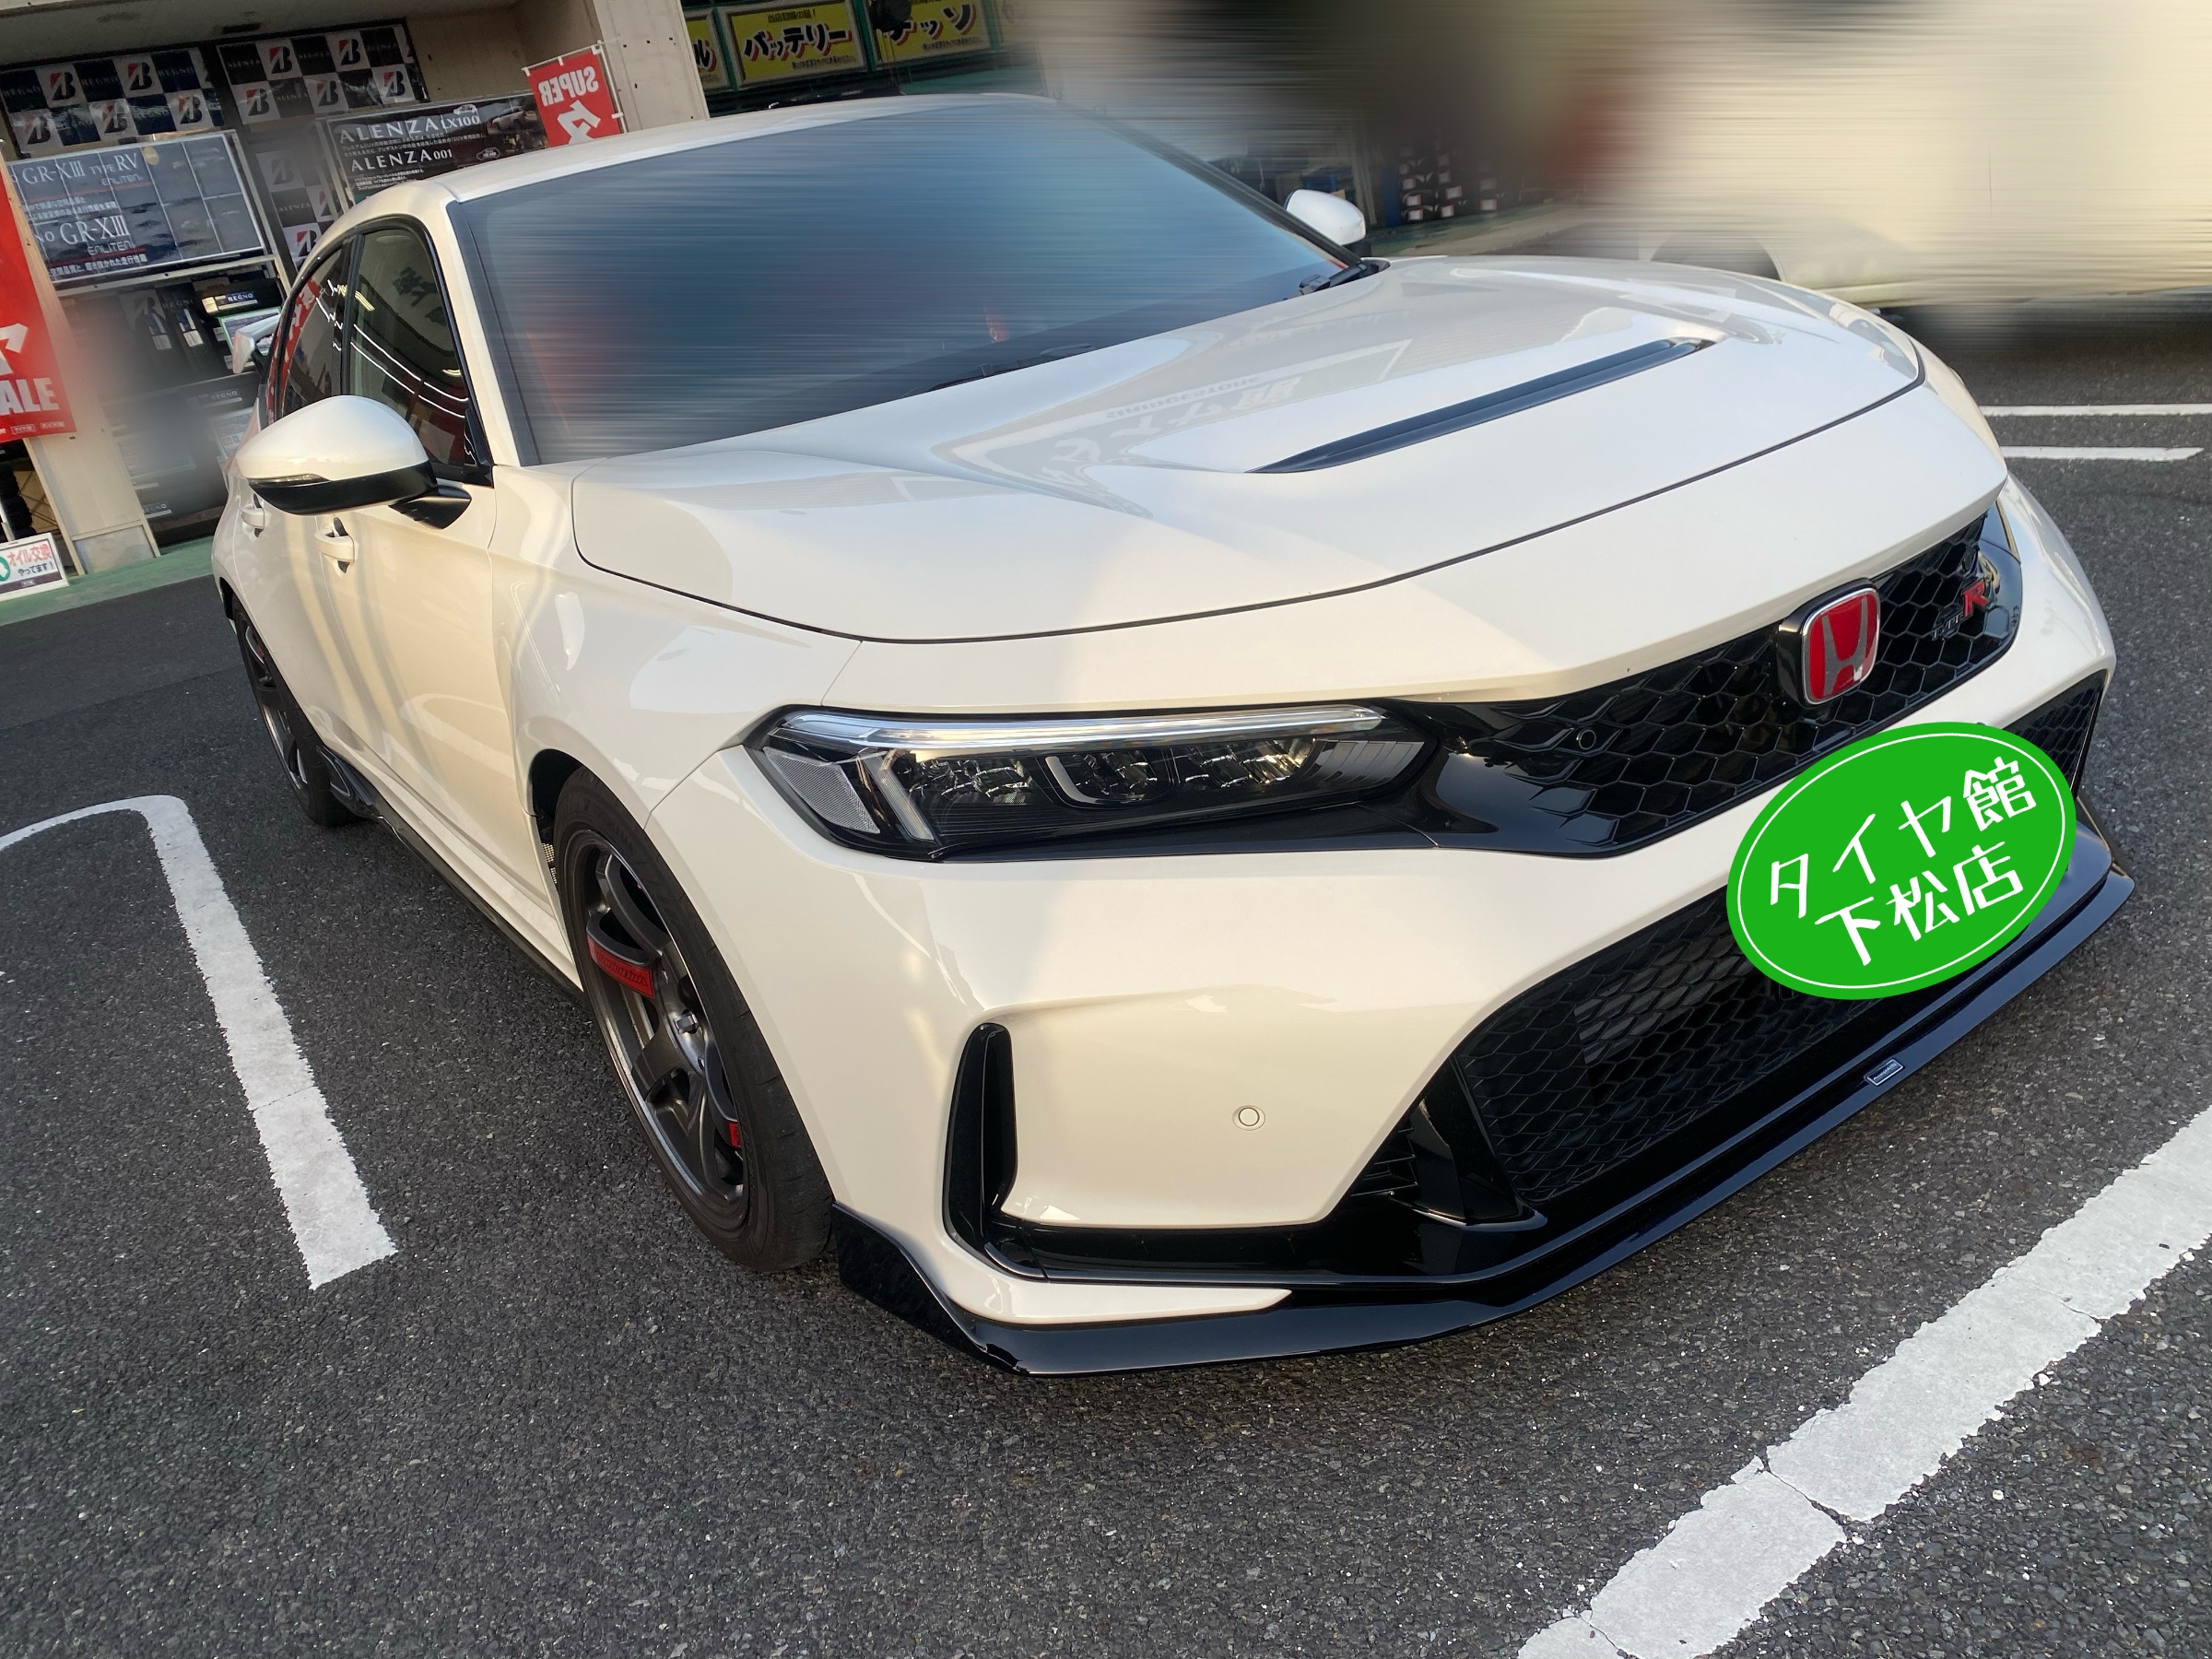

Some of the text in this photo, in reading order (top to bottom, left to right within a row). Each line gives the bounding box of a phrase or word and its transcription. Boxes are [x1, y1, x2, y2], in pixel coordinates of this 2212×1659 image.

[743, 23, 852, 61] バッテリー
[339, 116, 440, 145] ALENZA
[113, 152, 138, 172] RV
[351, 147, 453, 172] ALENZA 001
[228, 291, 253, 302] REGNO
[0, 377, 60, 416] ALE
[1960, 578, 1990, 618] R
